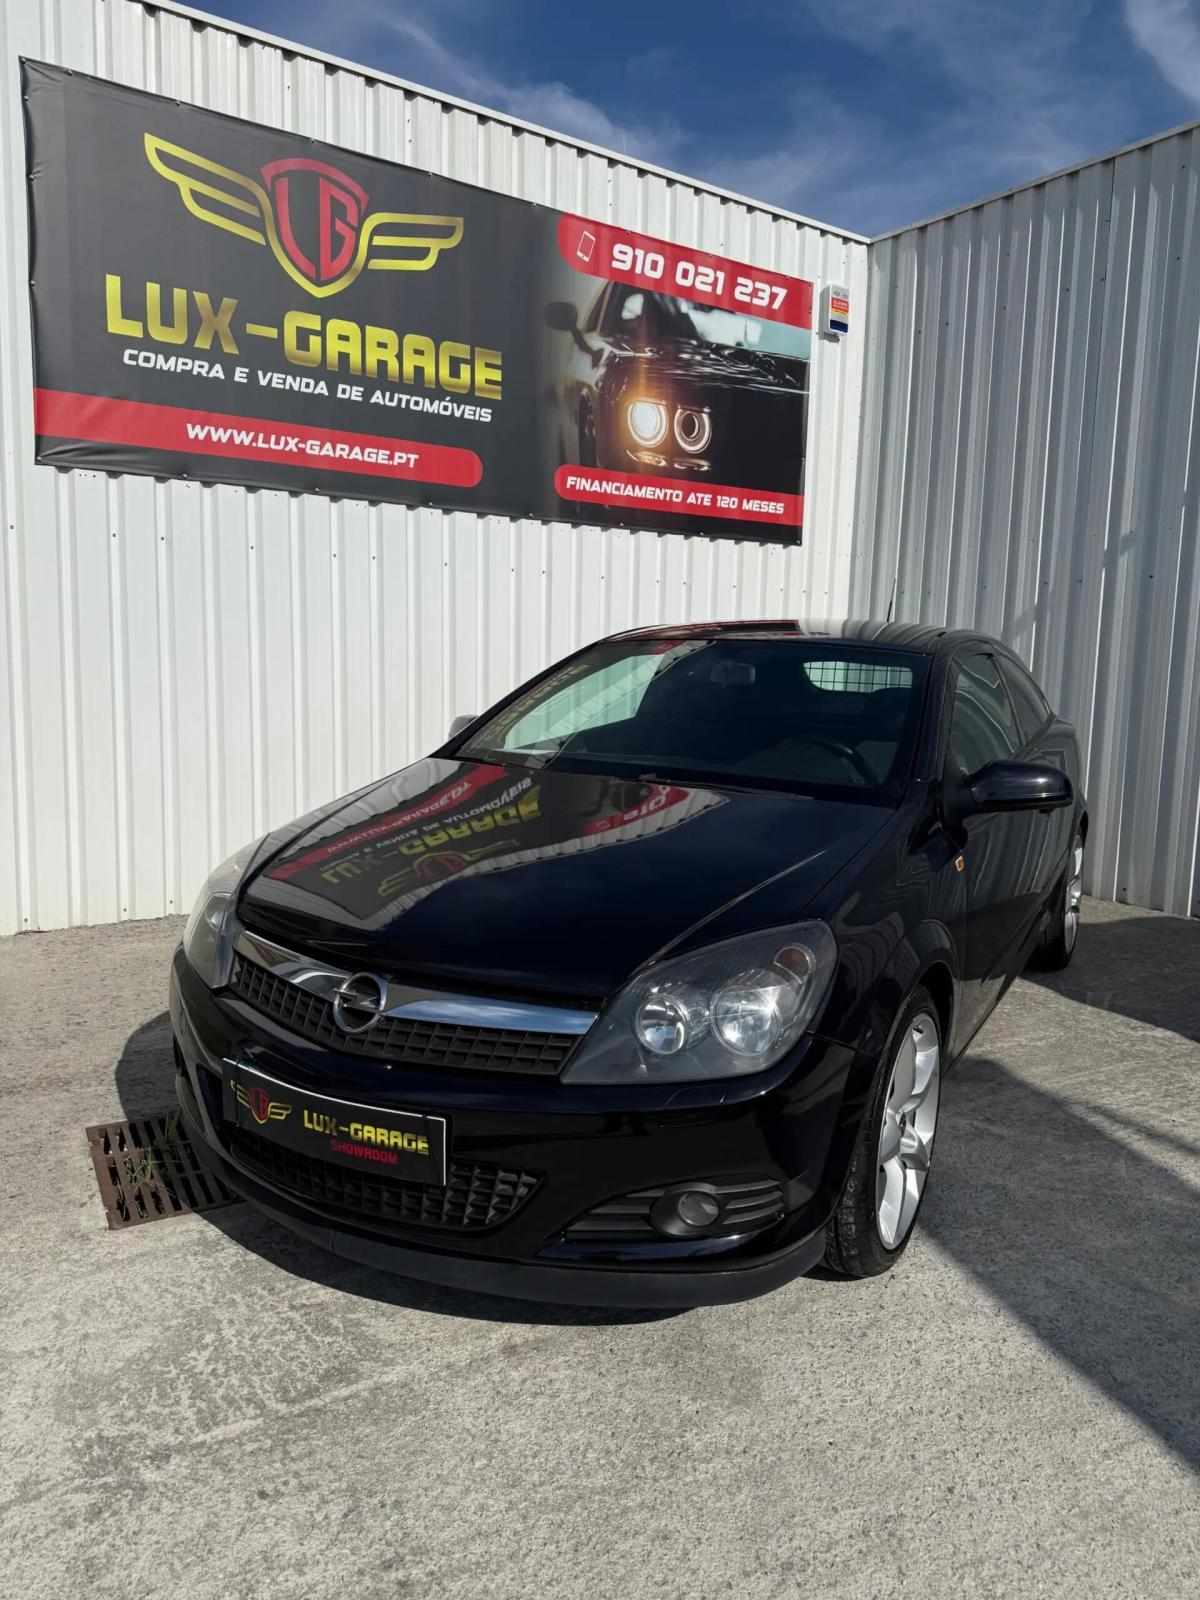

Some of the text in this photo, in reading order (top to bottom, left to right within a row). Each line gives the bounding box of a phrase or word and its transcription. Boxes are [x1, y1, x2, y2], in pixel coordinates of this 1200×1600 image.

[611, 243, 788, 311] 910 021 237
[105, 273, 503, 400] LUX-GARAGE
[122, 348, 493, 423] COMPRA E VENDA DE AUTOMÓVEIS
[185, 422, 420, 469] WWW.LUX-GARAGE.PT
[566, 475, 684, 503] FINANCIAMENTO
[716, 494, 738, 510] 120
[742, 499, 785, 515] MESES
[303, 1109, 430, 1156] LUX-GARAGE
[330, 1136, 401, 1166] SHOWROOM
